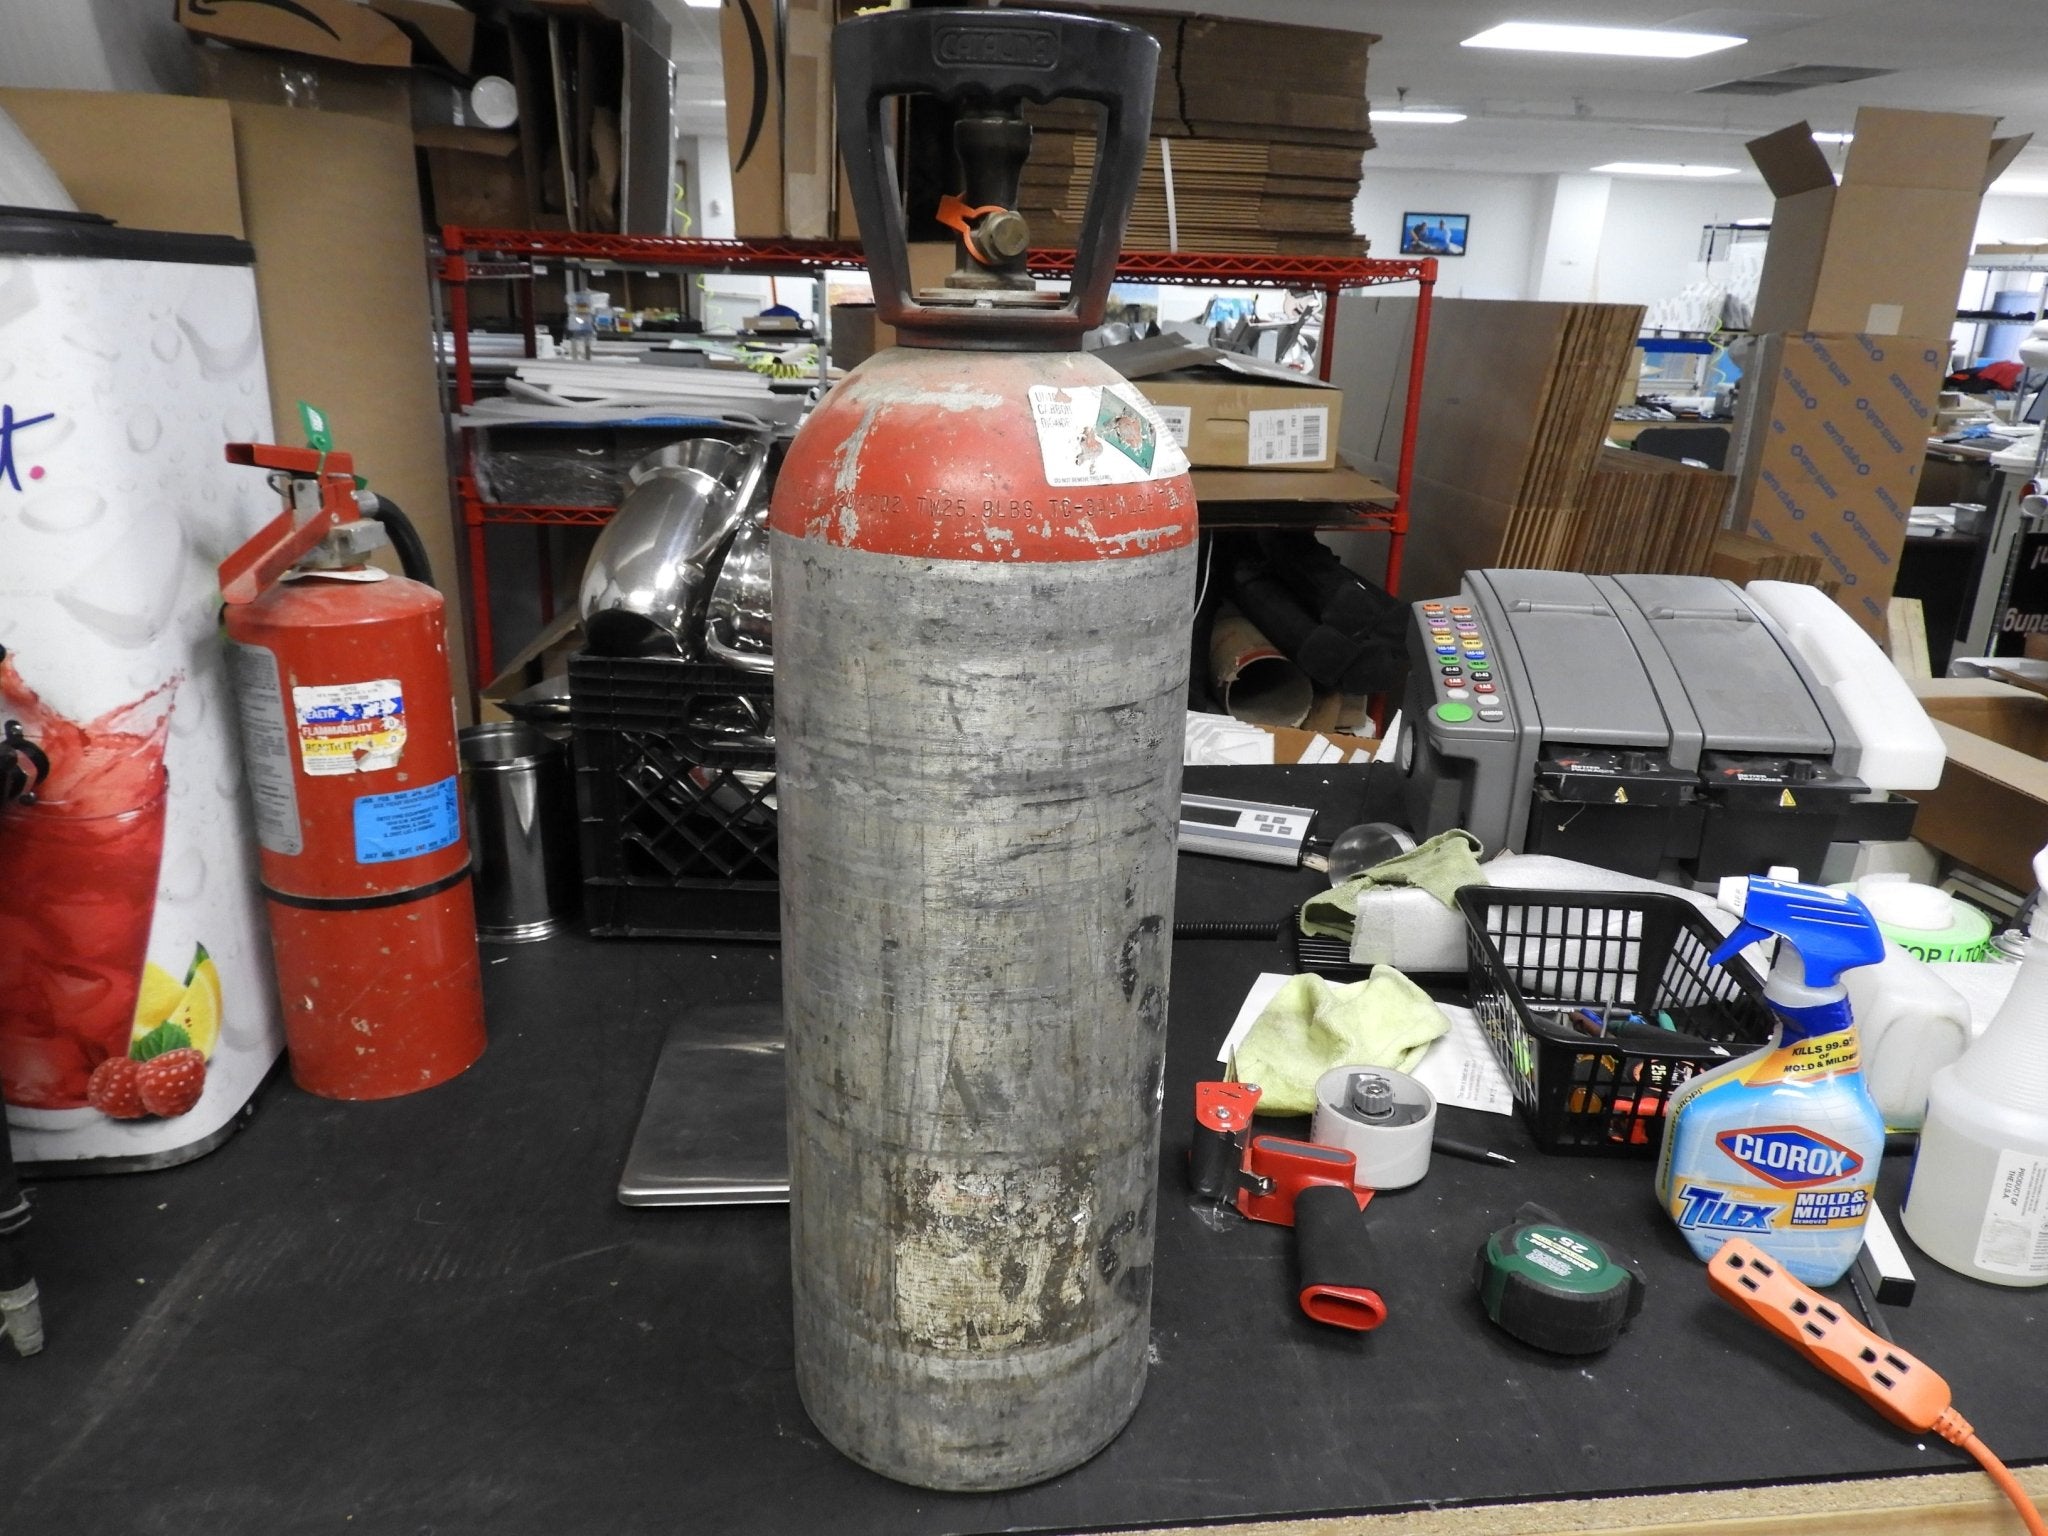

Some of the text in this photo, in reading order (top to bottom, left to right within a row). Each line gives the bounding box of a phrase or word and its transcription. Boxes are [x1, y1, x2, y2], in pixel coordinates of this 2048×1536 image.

[302, 722, 373, 736] FLAMMABILITY
[1792, 1045, 1823, 1056] KILLS
[1819, 1052, 1830, 1060] OF
[1783, 1063, 1815, 1073] MOLD
[1733, 1133, 1848, 1177] CLOROX
[2006, 1170, 2016, 1182] THE
[2012, 1167, 2026, 1197] PRODUCT
[1681, 1185, 1779, 1231] TILEX
[1794, 1203, 1866, 1221] MILDEW
